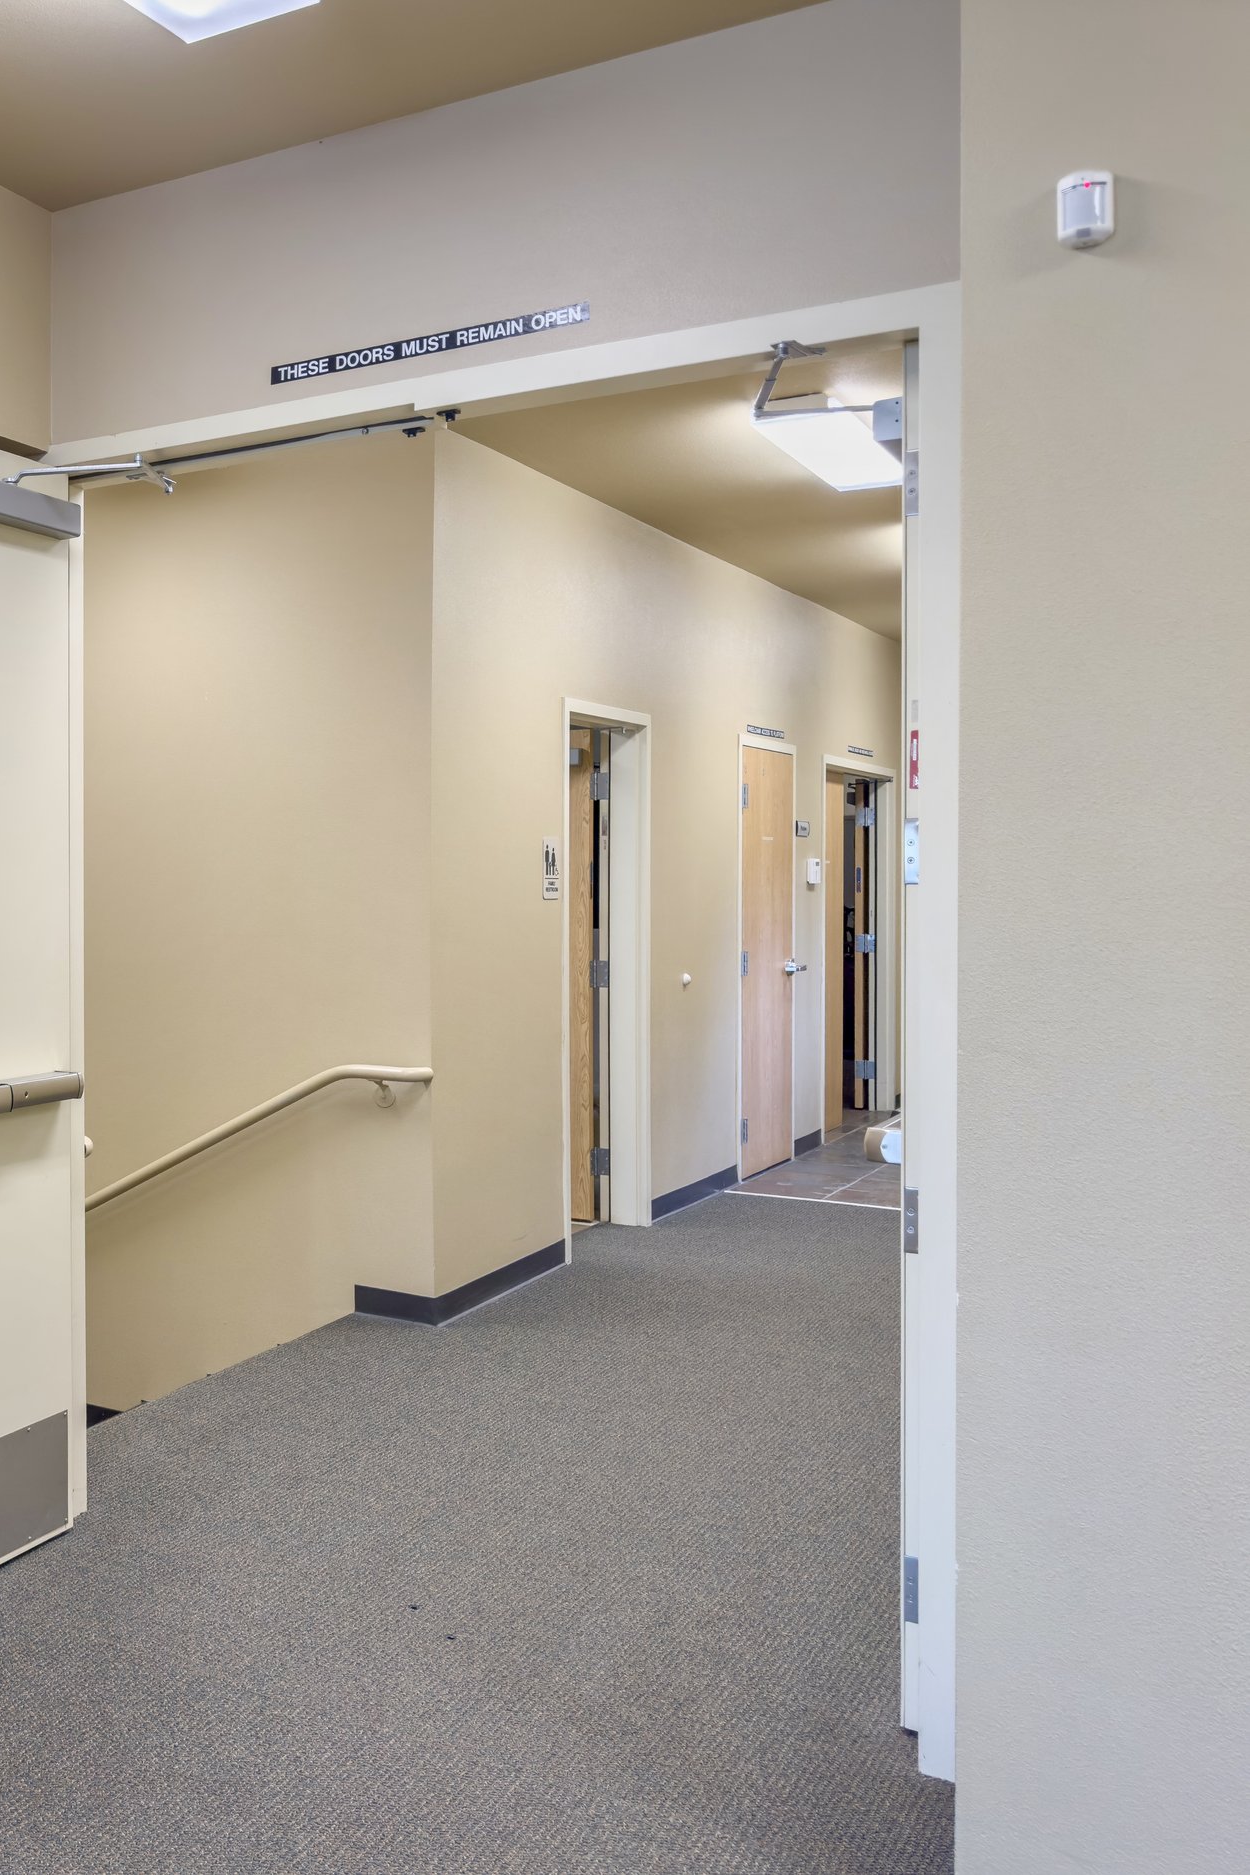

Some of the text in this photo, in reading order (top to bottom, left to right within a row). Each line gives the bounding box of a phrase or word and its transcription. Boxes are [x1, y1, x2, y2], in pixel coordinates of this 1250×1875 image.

[277, 305, 582, 382] THESE DOORS MUST REMAIN OPEN
